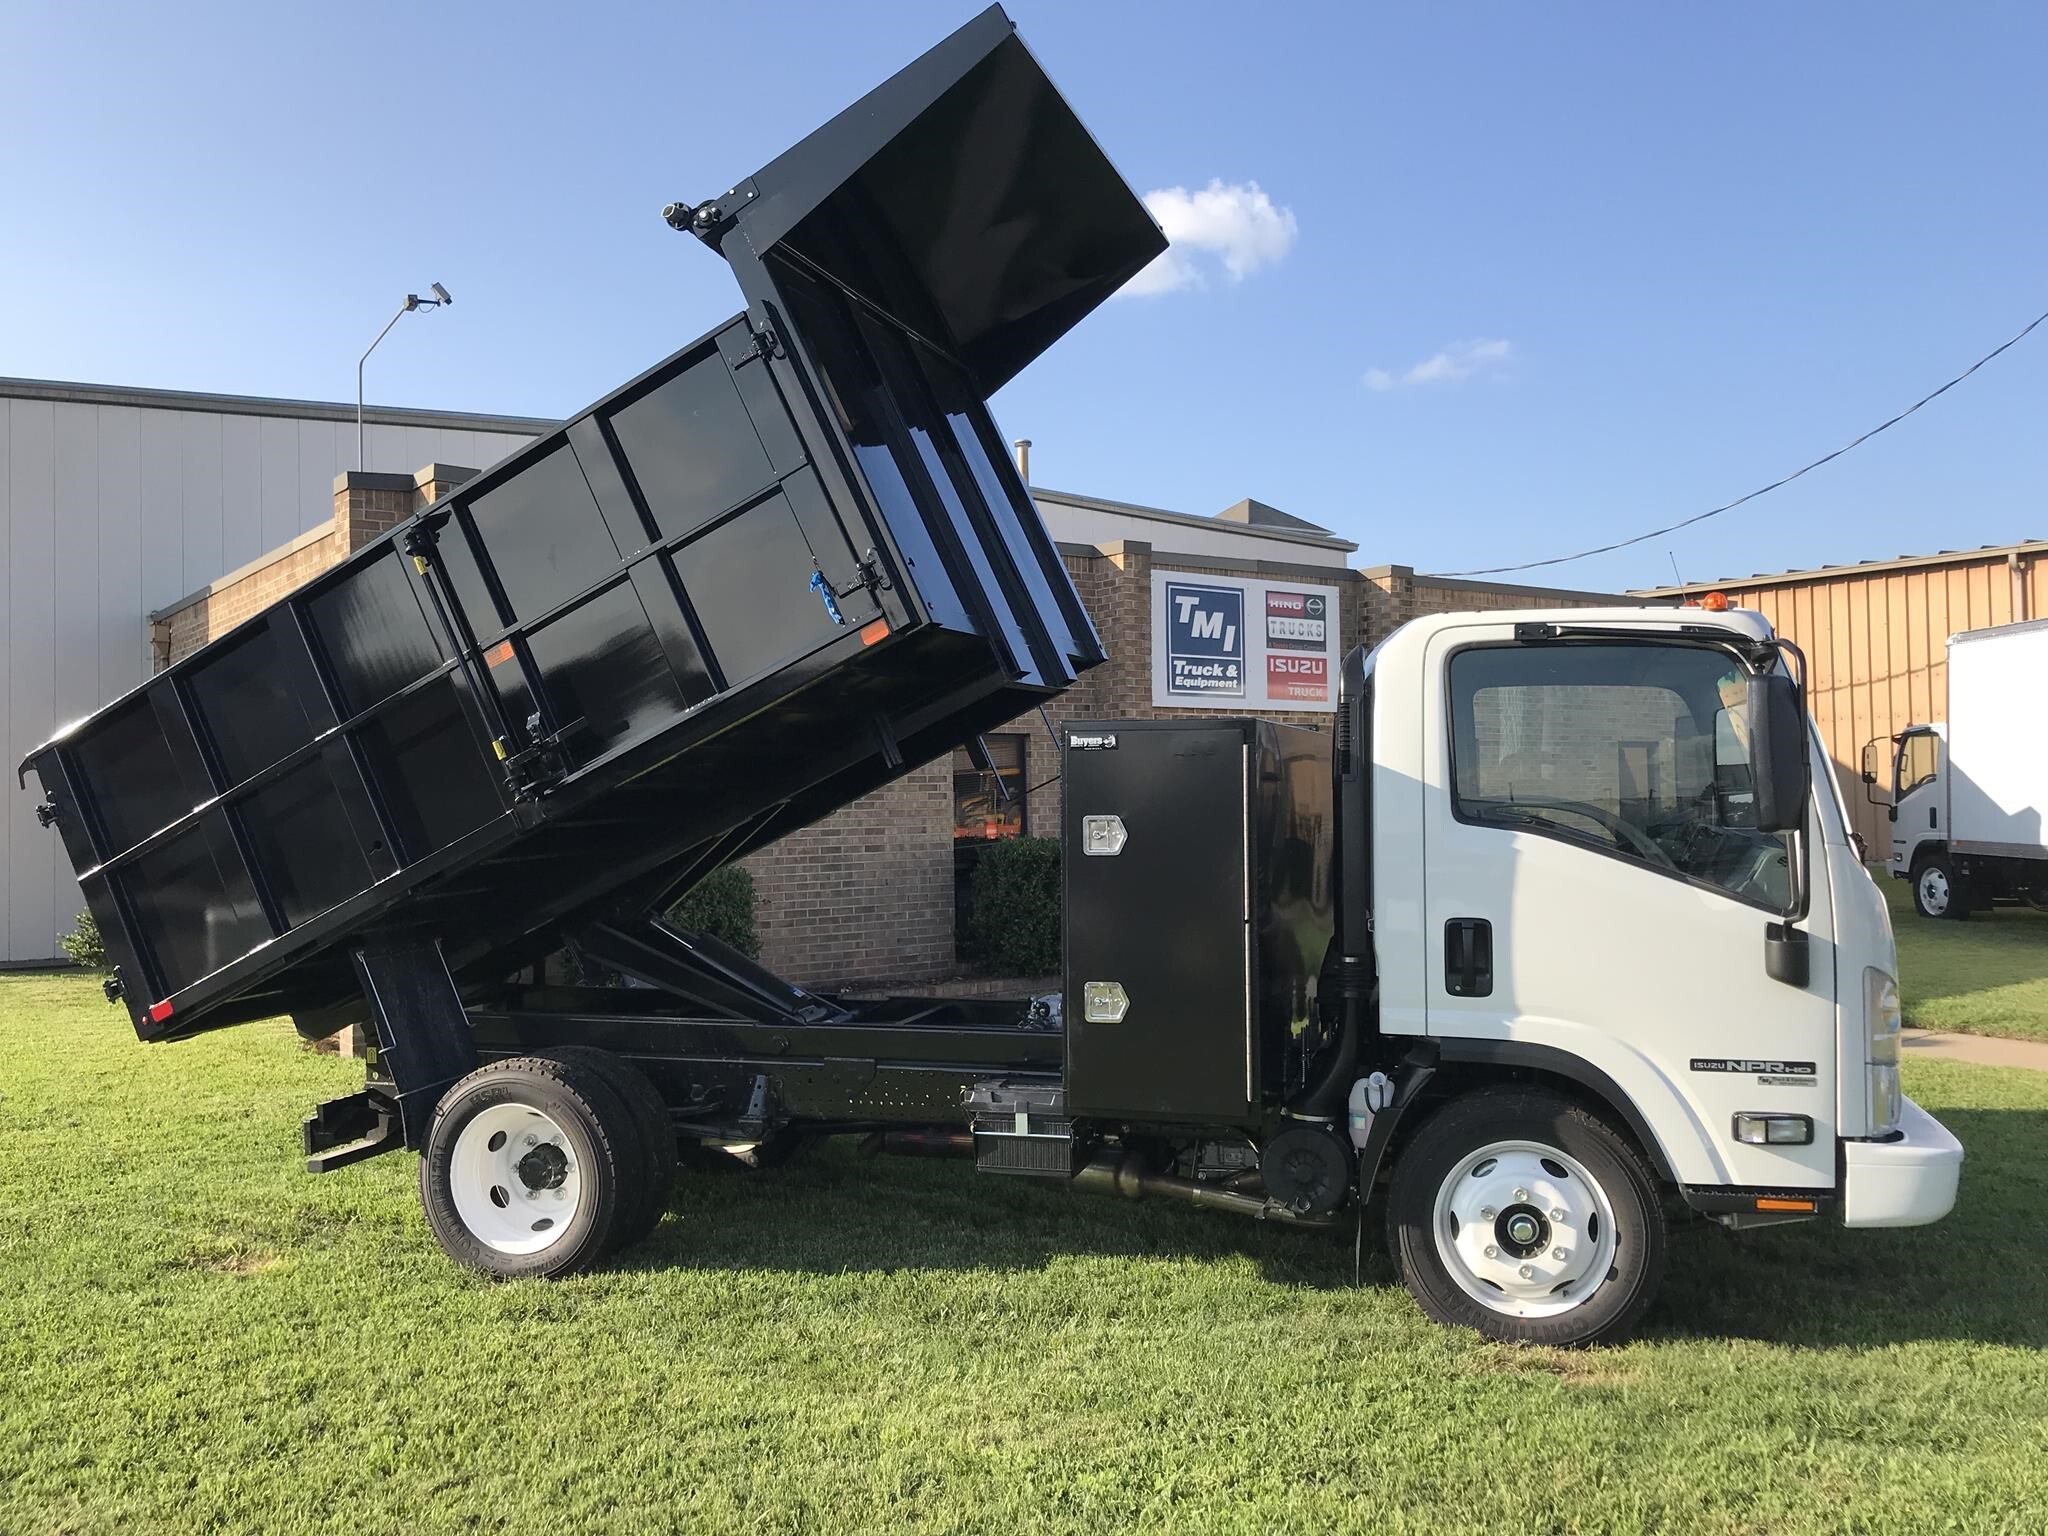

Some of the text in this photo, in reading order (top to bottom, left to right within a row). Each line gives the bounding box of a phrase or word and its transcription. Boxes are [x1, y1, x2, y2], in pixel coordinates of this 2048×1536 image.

[1269, 599, 1302, 610] HINO
[1175, 595, 1236, 652] TMI
[1270, 620, 1323, 637] TRUCKS
[1174, 660, 1238, 678] Truck &
[1270, 658, 1323, 675] ISUZU
[1175, 676, 1238, 689] Equipment
[1288, 686, 1323, 697] TRUCK
[1070, 735, 1103, 747] Buyers
